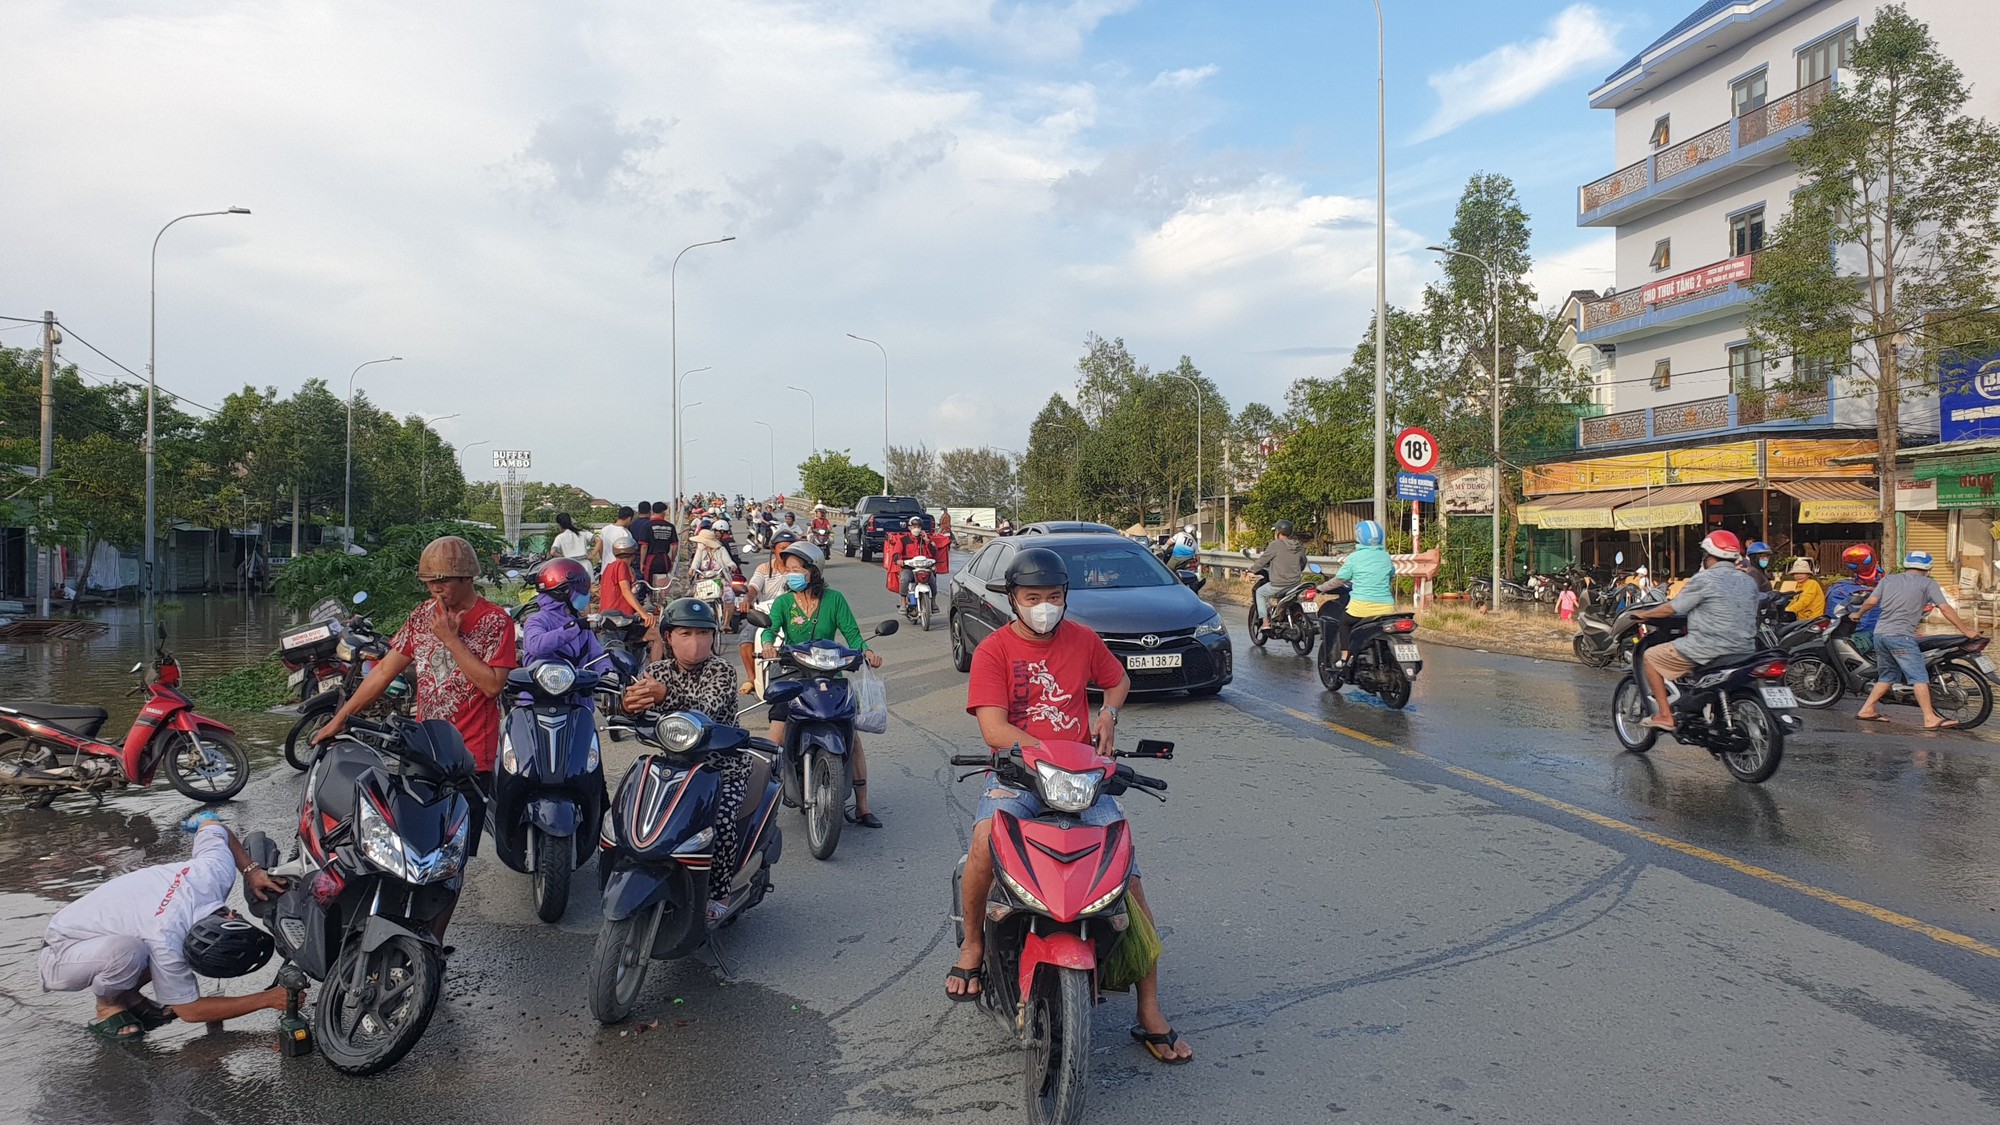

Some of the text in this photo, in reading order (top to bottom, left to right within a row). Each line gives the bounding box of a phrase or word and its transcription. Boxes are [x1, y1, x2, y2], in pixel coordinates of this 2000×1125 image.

[1696, 275, 1702, 287] 2
[493, 451, 530, 459] BUFFET
[493, 460, 530, 468] BAMBO
[155, 873, 181, 917] HONDA
